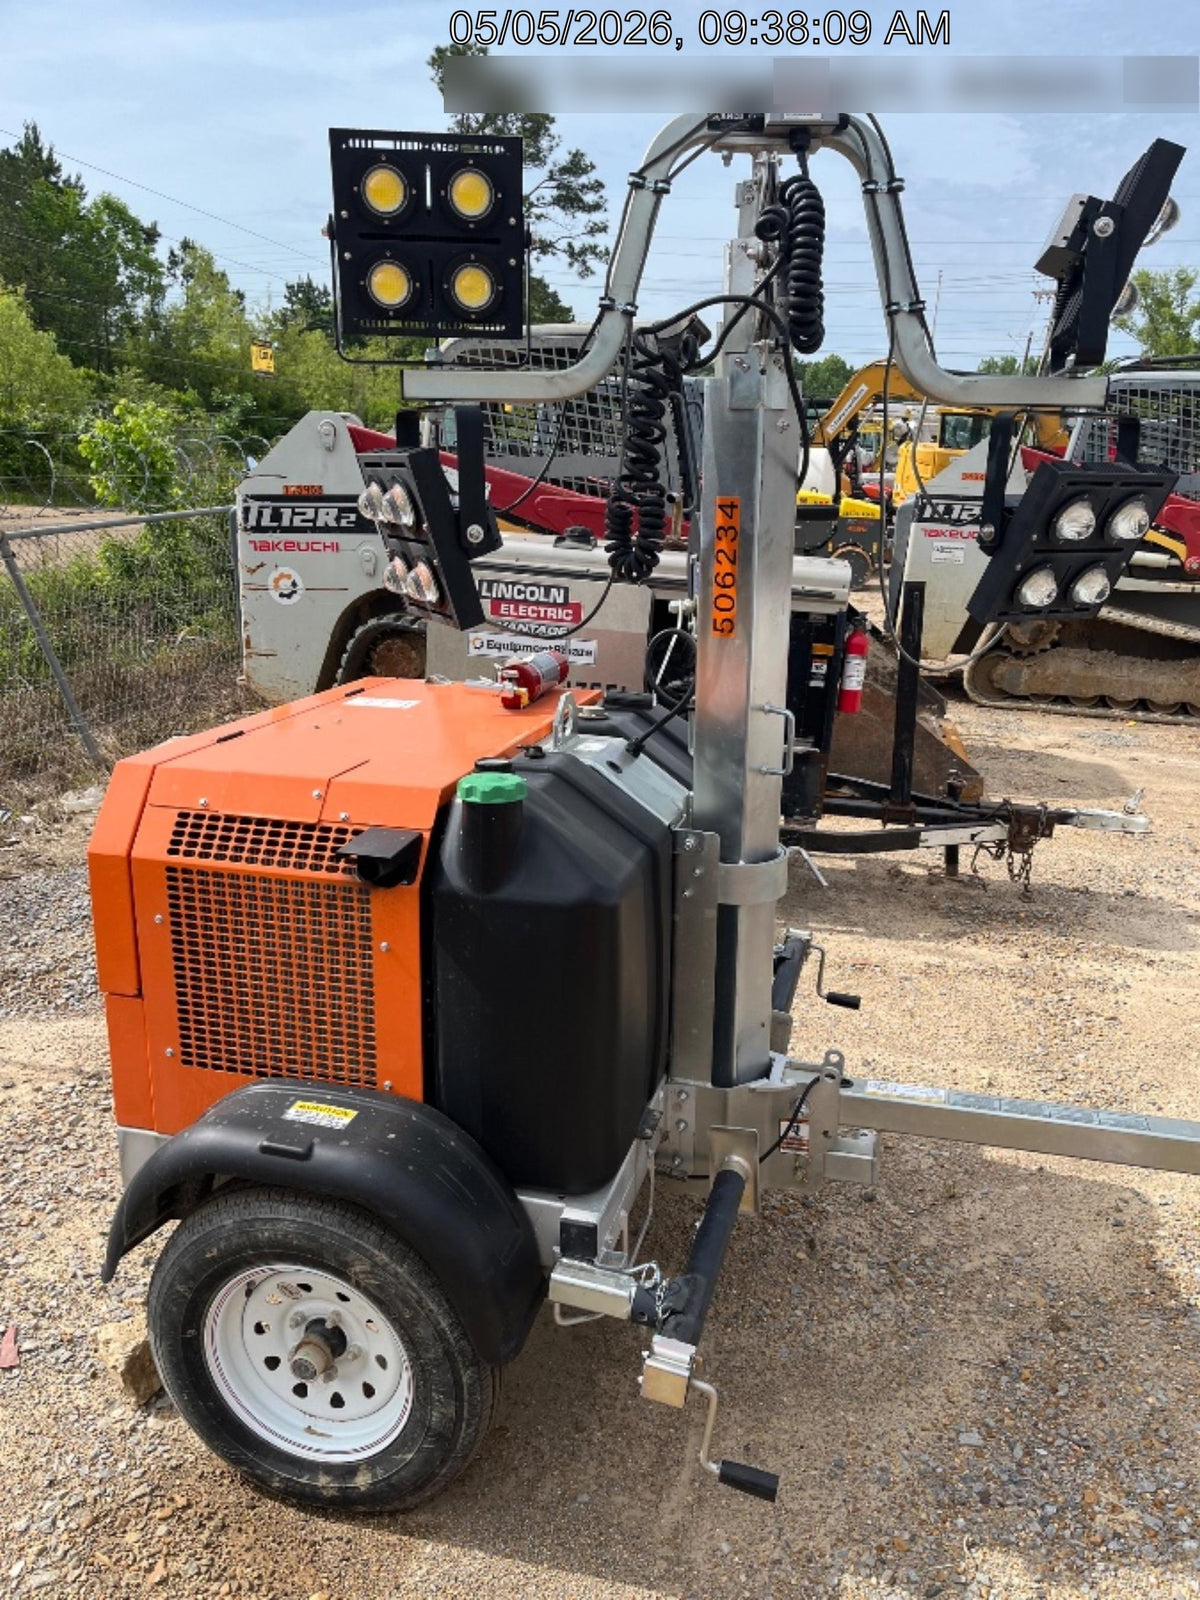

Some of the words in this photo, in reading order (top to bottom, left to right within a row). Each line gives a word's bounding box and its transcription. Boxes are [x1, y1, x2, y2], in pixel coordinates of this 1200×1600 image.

[248, 540, 340, 553] TAKEUCHI
[712, 501, 739, 635] 506234
[481, 582, 565, 604] LINCOLN
[499, 603, 573, 620] ELECTRIC
